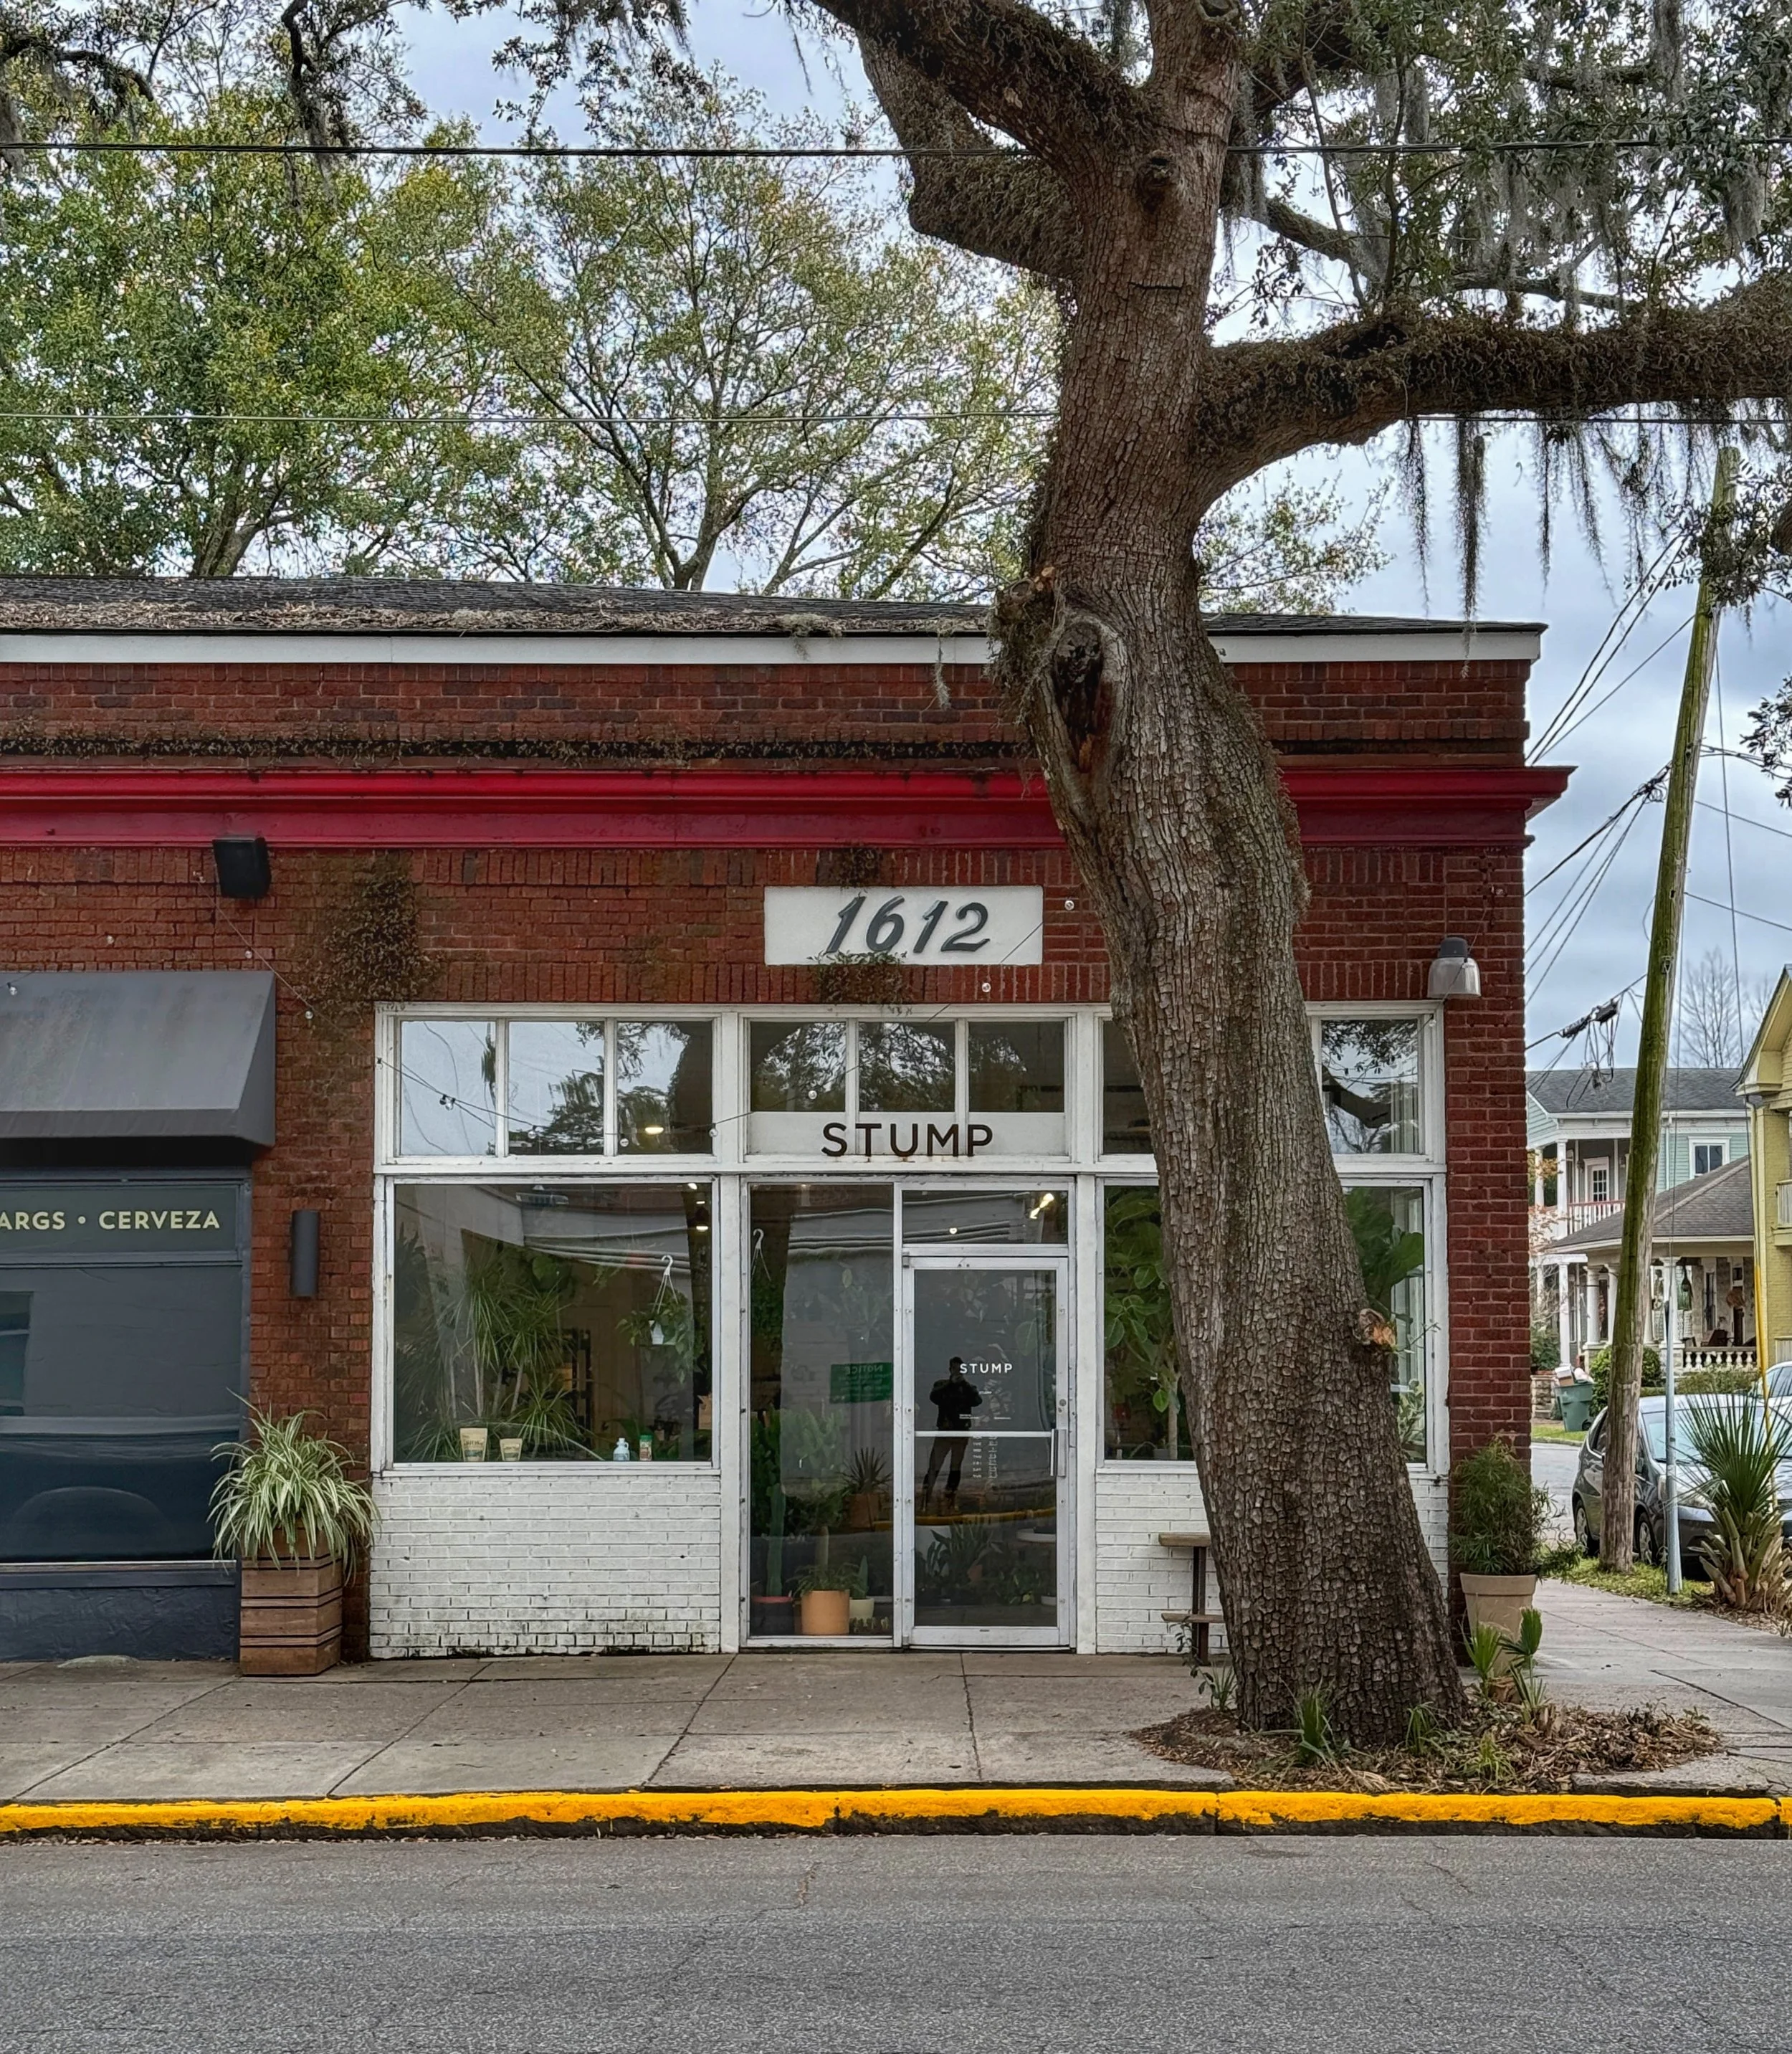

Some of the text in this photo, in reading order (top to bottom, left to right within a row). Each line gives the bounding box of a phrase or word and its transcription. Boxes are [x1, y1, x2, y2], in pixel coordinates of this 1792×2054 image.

[826, 895, 990, 954] 1612
[821, 1122, 993, 1157] STUMP
[0, 1211, 219, 1230] ARGS CERVEZA
[960, 1363, 1013, 1374] STUMP
